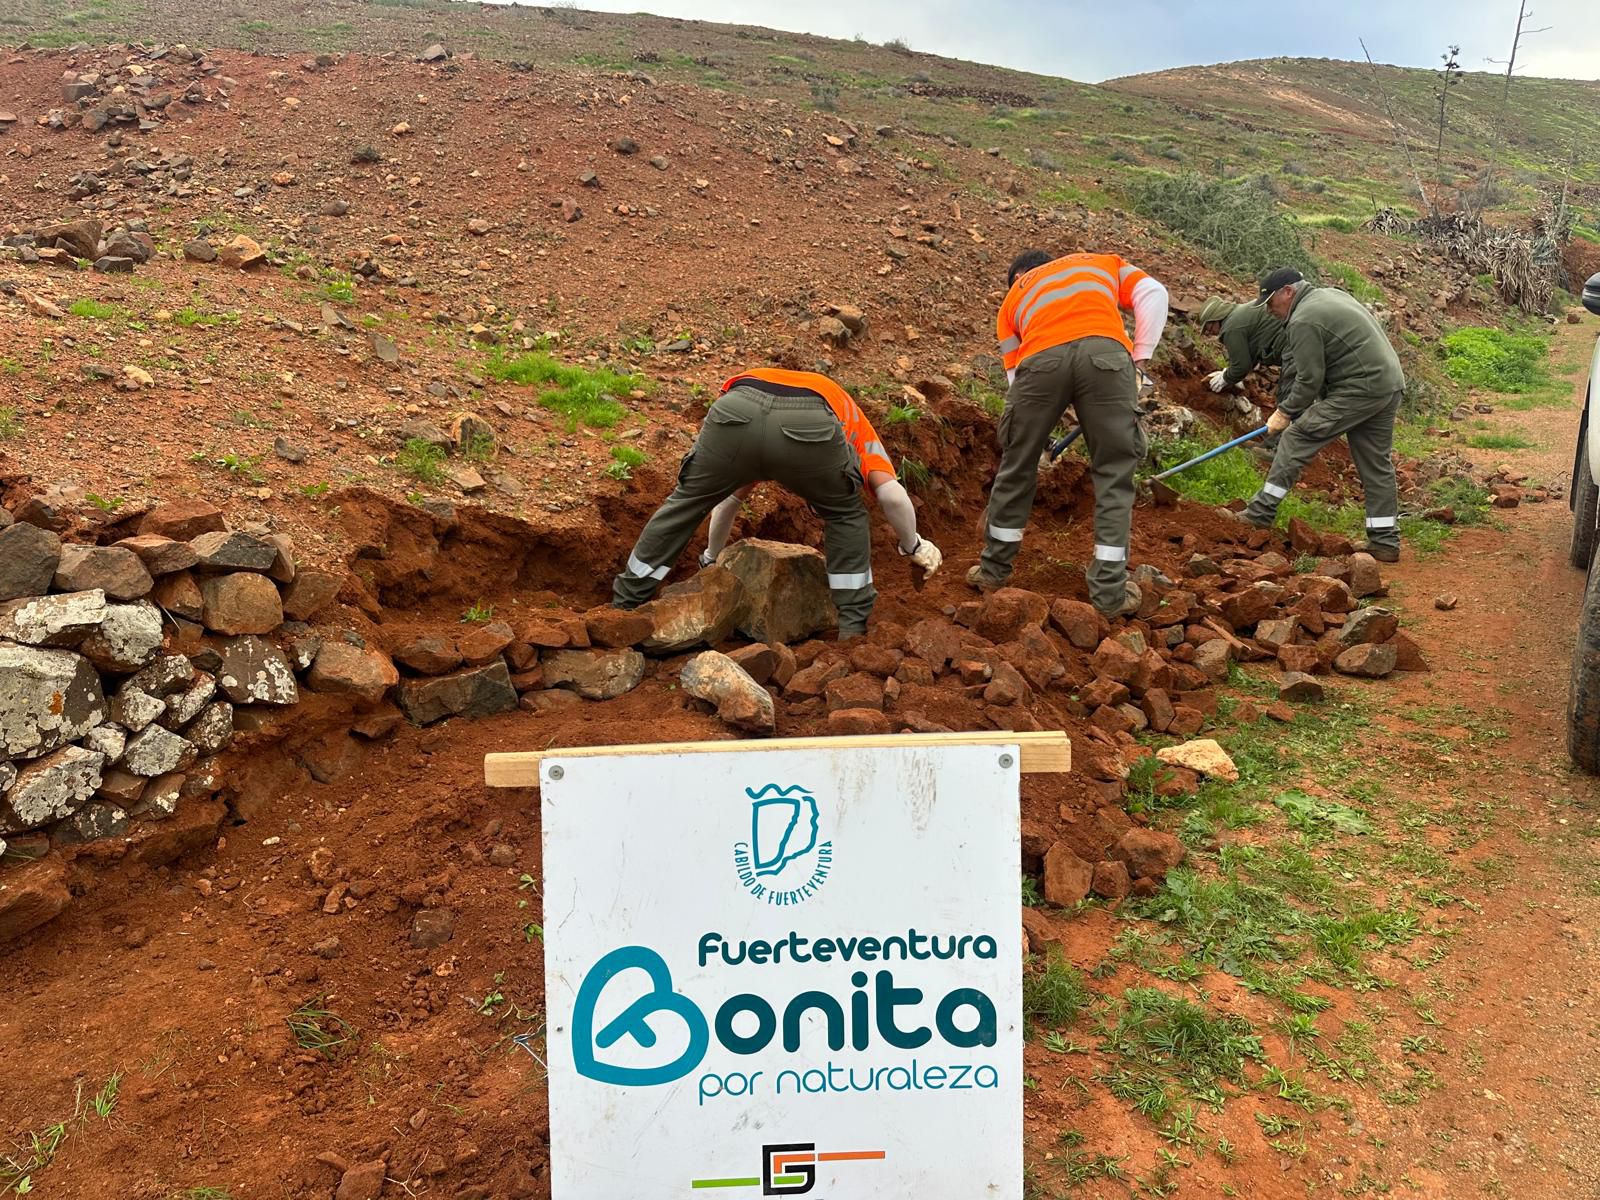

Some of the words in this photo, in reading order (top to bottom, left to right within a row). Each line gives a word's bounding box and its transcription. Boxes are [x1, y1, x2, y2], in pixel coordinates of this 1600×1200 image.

[734, 841, 756, 887] CABILDO
[750, 883, 766, 900] DE
[768, 840, 833, 906] FUERTEVENTURA
[699, 928, 997, 966] Fuerteventura
[699, 1071, 763, 1106] por
[776, 1059, 999, 1095] naturaleza
